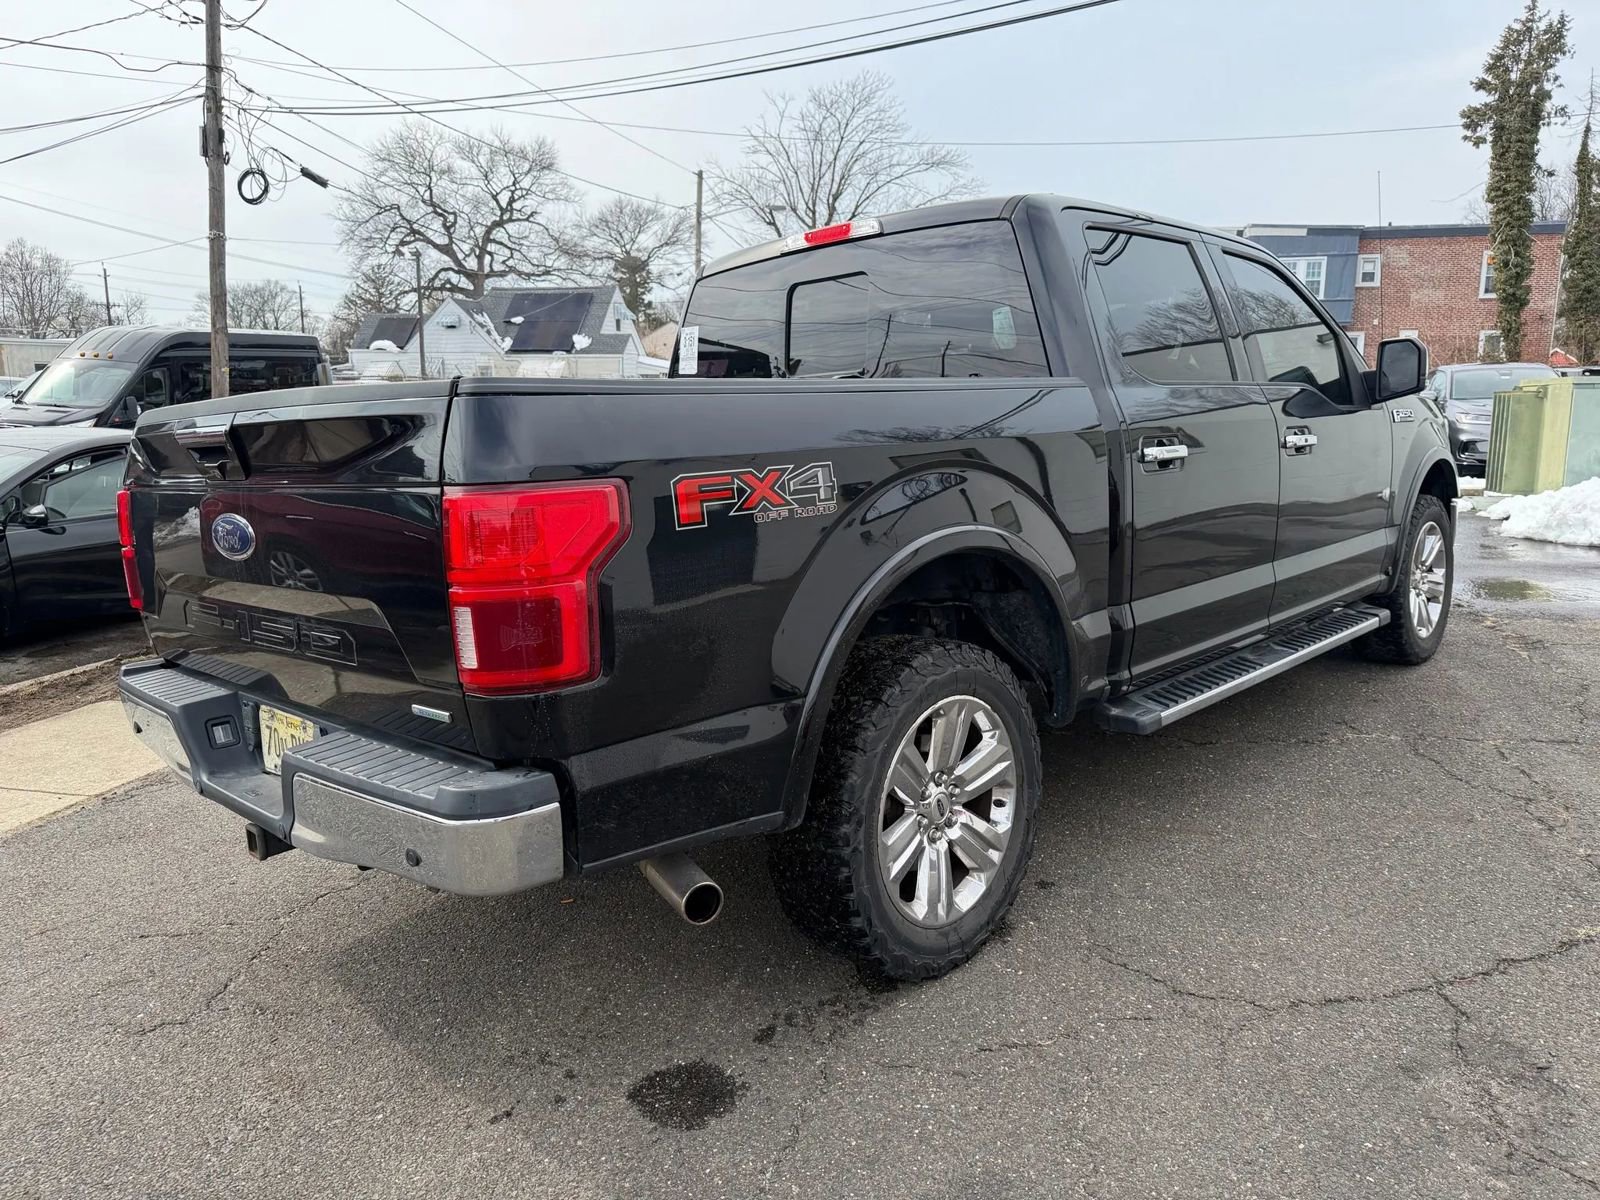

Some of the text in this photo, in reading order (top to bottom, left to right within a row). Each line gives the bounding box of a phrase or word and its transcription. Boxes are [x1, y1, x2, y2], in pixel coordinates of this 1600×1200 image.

[670, 462, 838, 530] FX4
[754, 503, 838, 524] OFF ROAD
